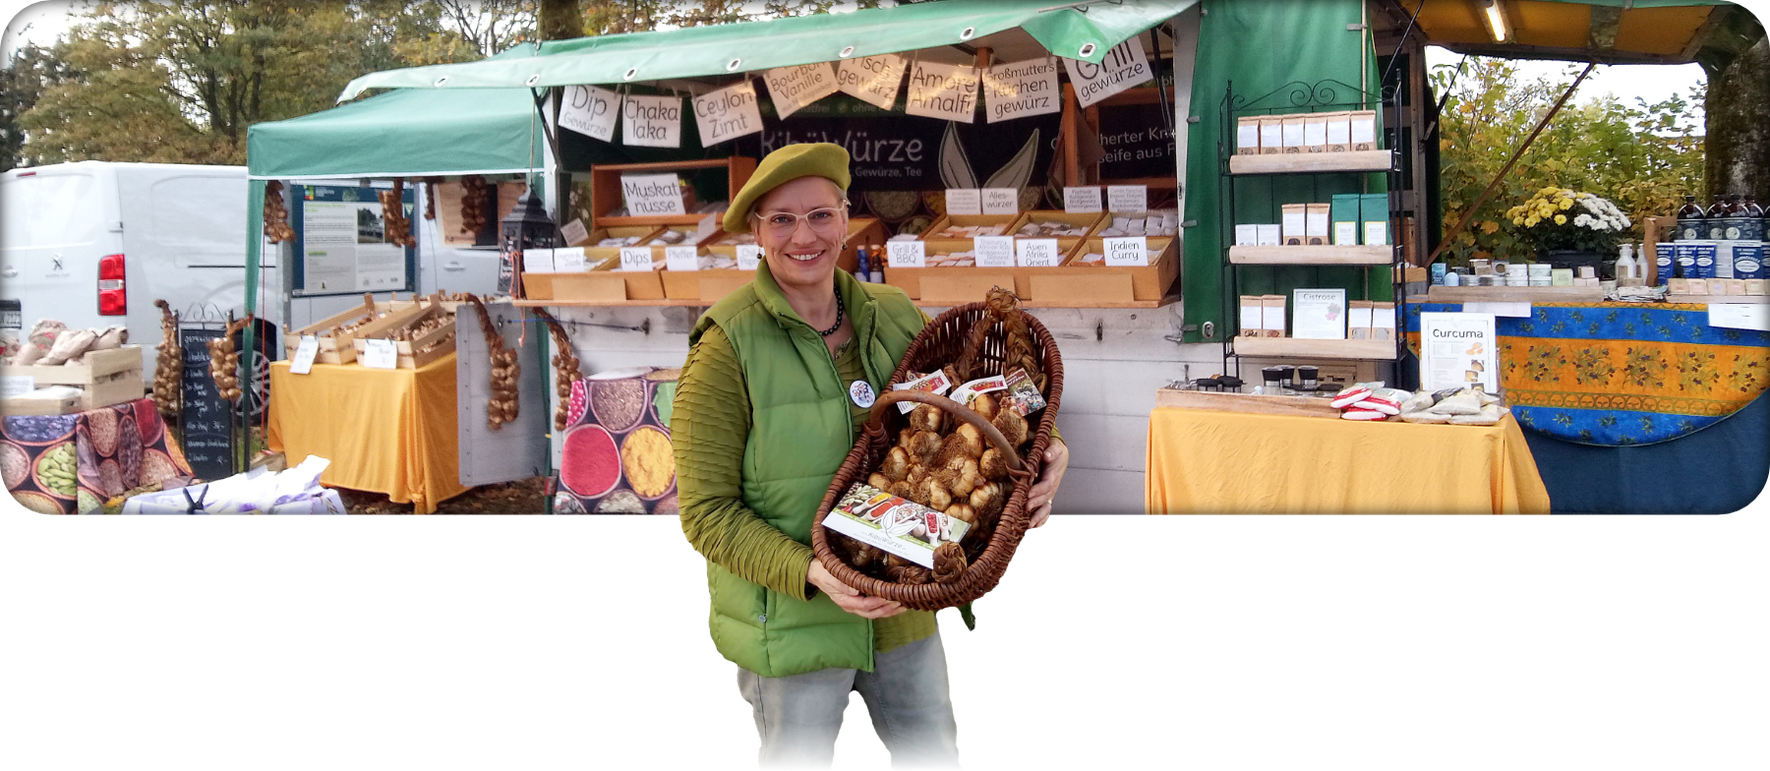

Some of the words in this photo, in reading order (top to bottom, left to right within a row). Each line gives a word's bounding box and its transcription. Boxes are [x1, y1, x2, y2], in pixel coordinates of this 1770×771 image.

[1075, 40, 1134, 80] Grill
[780, 72, 823, 99] Vanille
[912, 66, 976, 93] Amore
[1081, 63, 1144, 101] gewürze
[993, 79, 1048, 99] Küchen
[571, 85, 607, 116] Dip
[696, 89, 755, 119] Ceylon
[994, 95, 1050, 119] gewürz
[624, 100, 679, 121] Chaka
[564, 111, 607, 137] Gewürze
[632, 120, 667, 140] laka
[711, 115, 749, 139] Zimt
[1100, 130, 1143, 147] herter
[1136, 149, 1163, 162] aus
[855, 166, 902, 177] Gewürze,
[904, 166, 922, 176] Tee
[624, 181, 679, 199] Muskat
[634, 197, 677, 213] nüsse
[911, 243, 918, 254] &
[1025, 250, 1048, 258] Afrika
[1026, 242, 1047, 250] Asien
[1109, 240, 1140, 251] Indien
[623, 250, 649, 269] Dips
[668, 249, 694, 261] Pfeffer
[895, 253, 917, 265] BBQ
[1025, 258, 1050, 266] Orient
[1111, 250, 1140, 261] Curry
[1303, 292, 1336, 301] Cistrose
[1432, 328, 1484, 339] Curcuma
